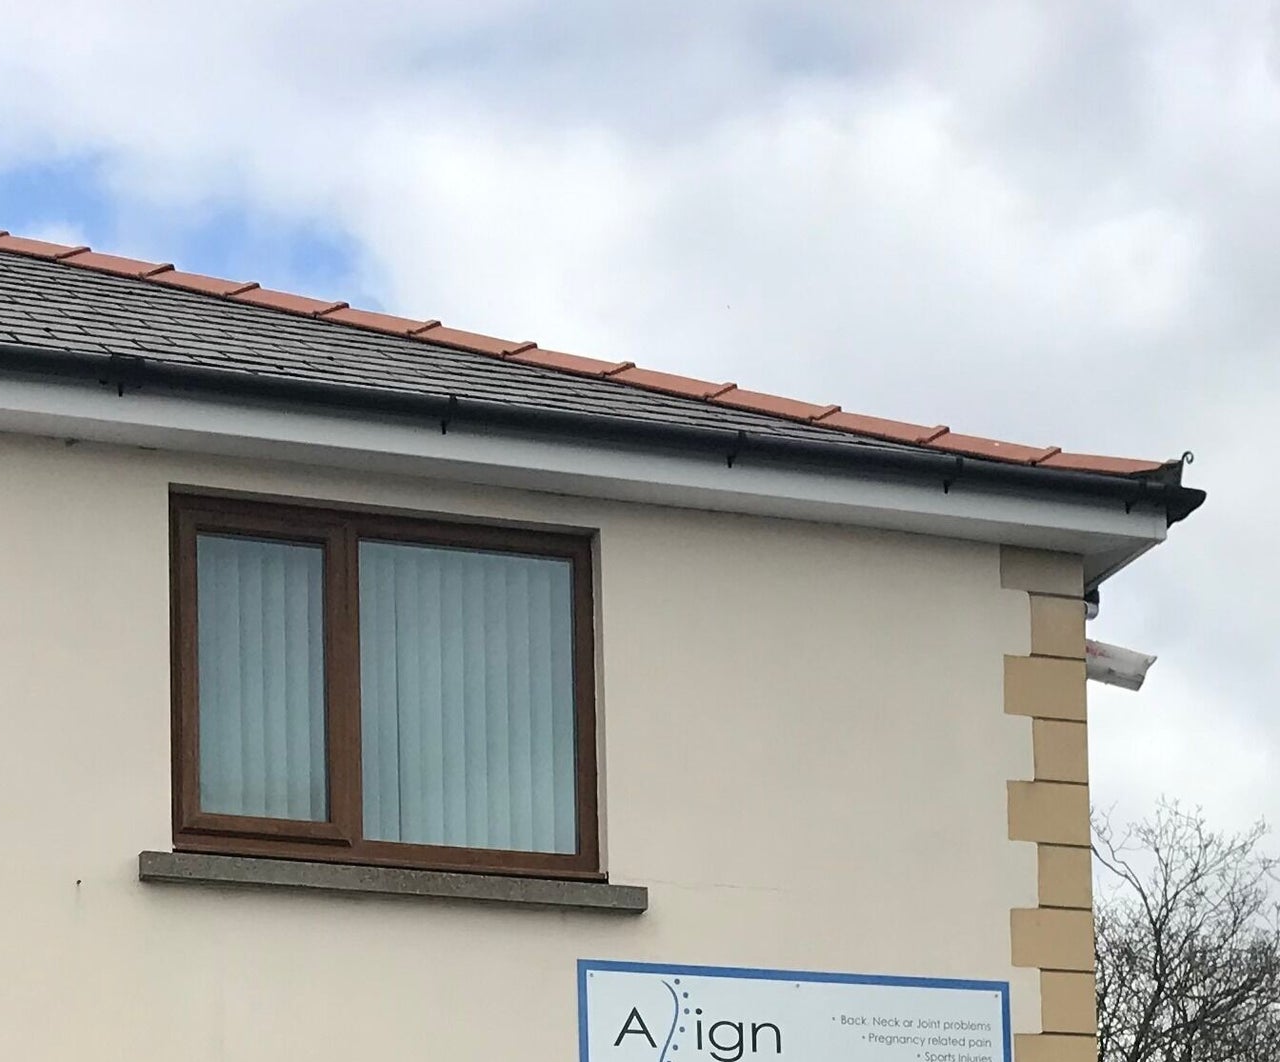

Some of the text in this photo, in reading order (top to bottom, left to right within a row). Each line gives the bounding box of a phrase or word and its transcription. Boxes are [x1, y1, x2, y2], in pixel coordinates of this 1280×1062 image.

[872, 1016, 901, 1029] Neck
[902, 1020, 914, 1029] or
[917, 1018, 941, 1031] Joint
[943, 1020, 992, 1033] problems
[868, 1033, 992, 1050] Pregnancy related pain
